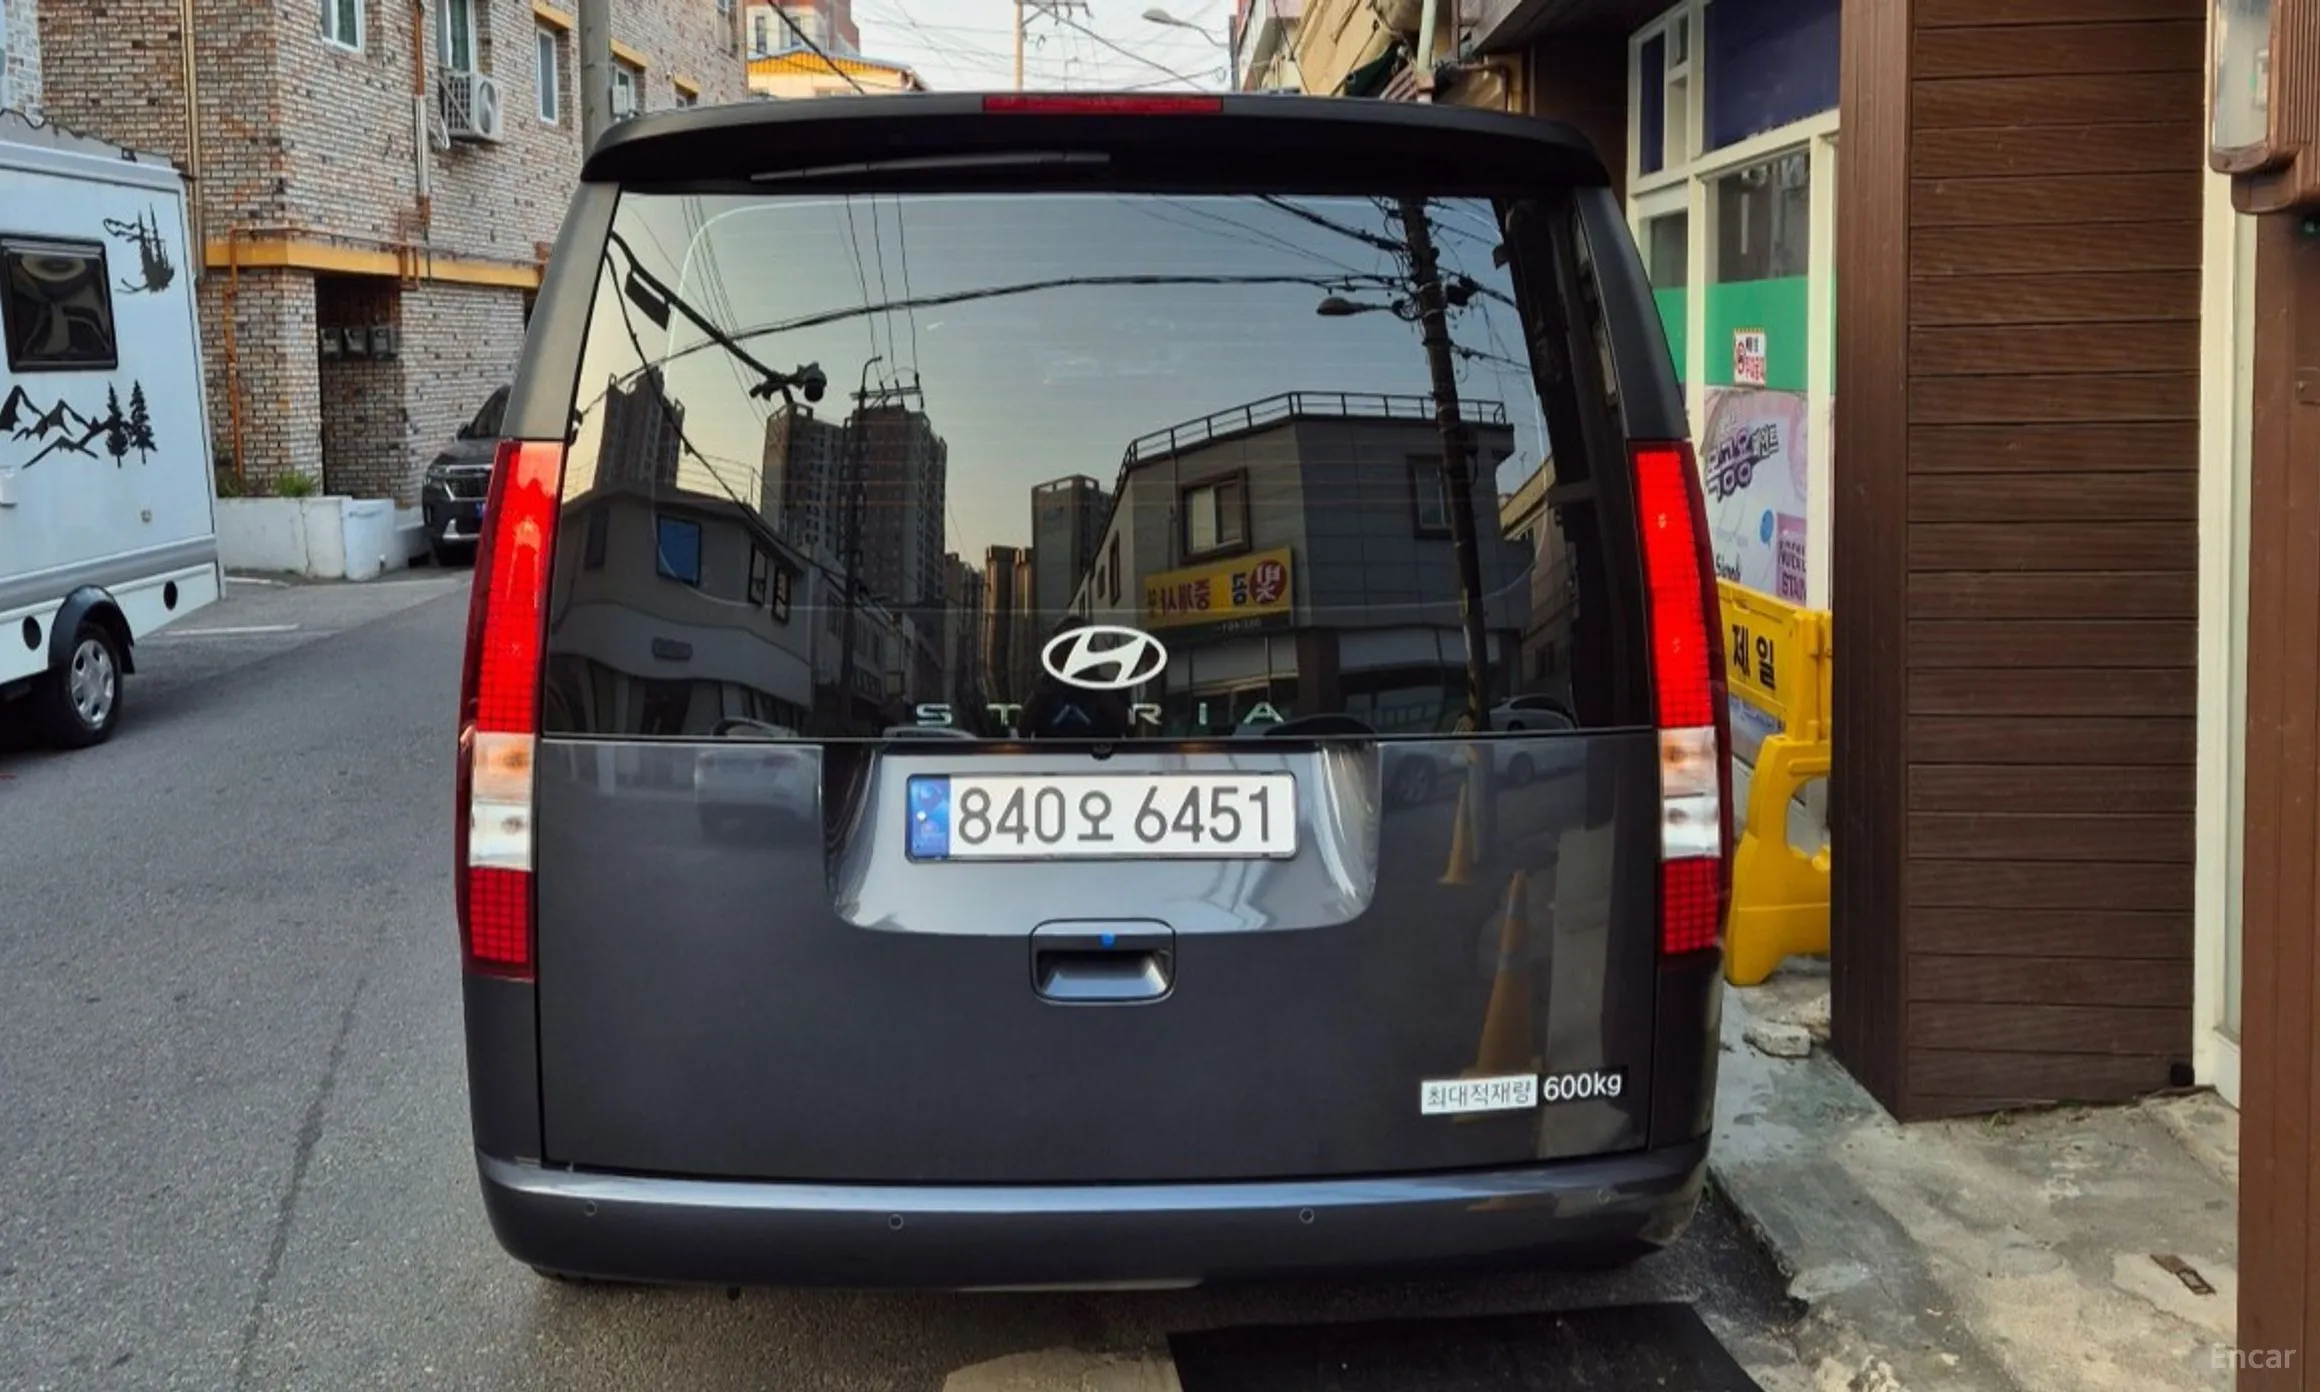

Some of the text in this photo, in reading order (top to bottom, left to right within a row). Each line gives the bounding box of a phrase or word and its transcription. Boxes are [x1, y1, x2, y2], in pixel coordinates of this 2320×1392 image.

[916, 701, 1284, 726] STARIA
[958, 786, 1269, 844] 840오 6451
[1427, 1071, 1622, 1107] 최대적재량 600kg
